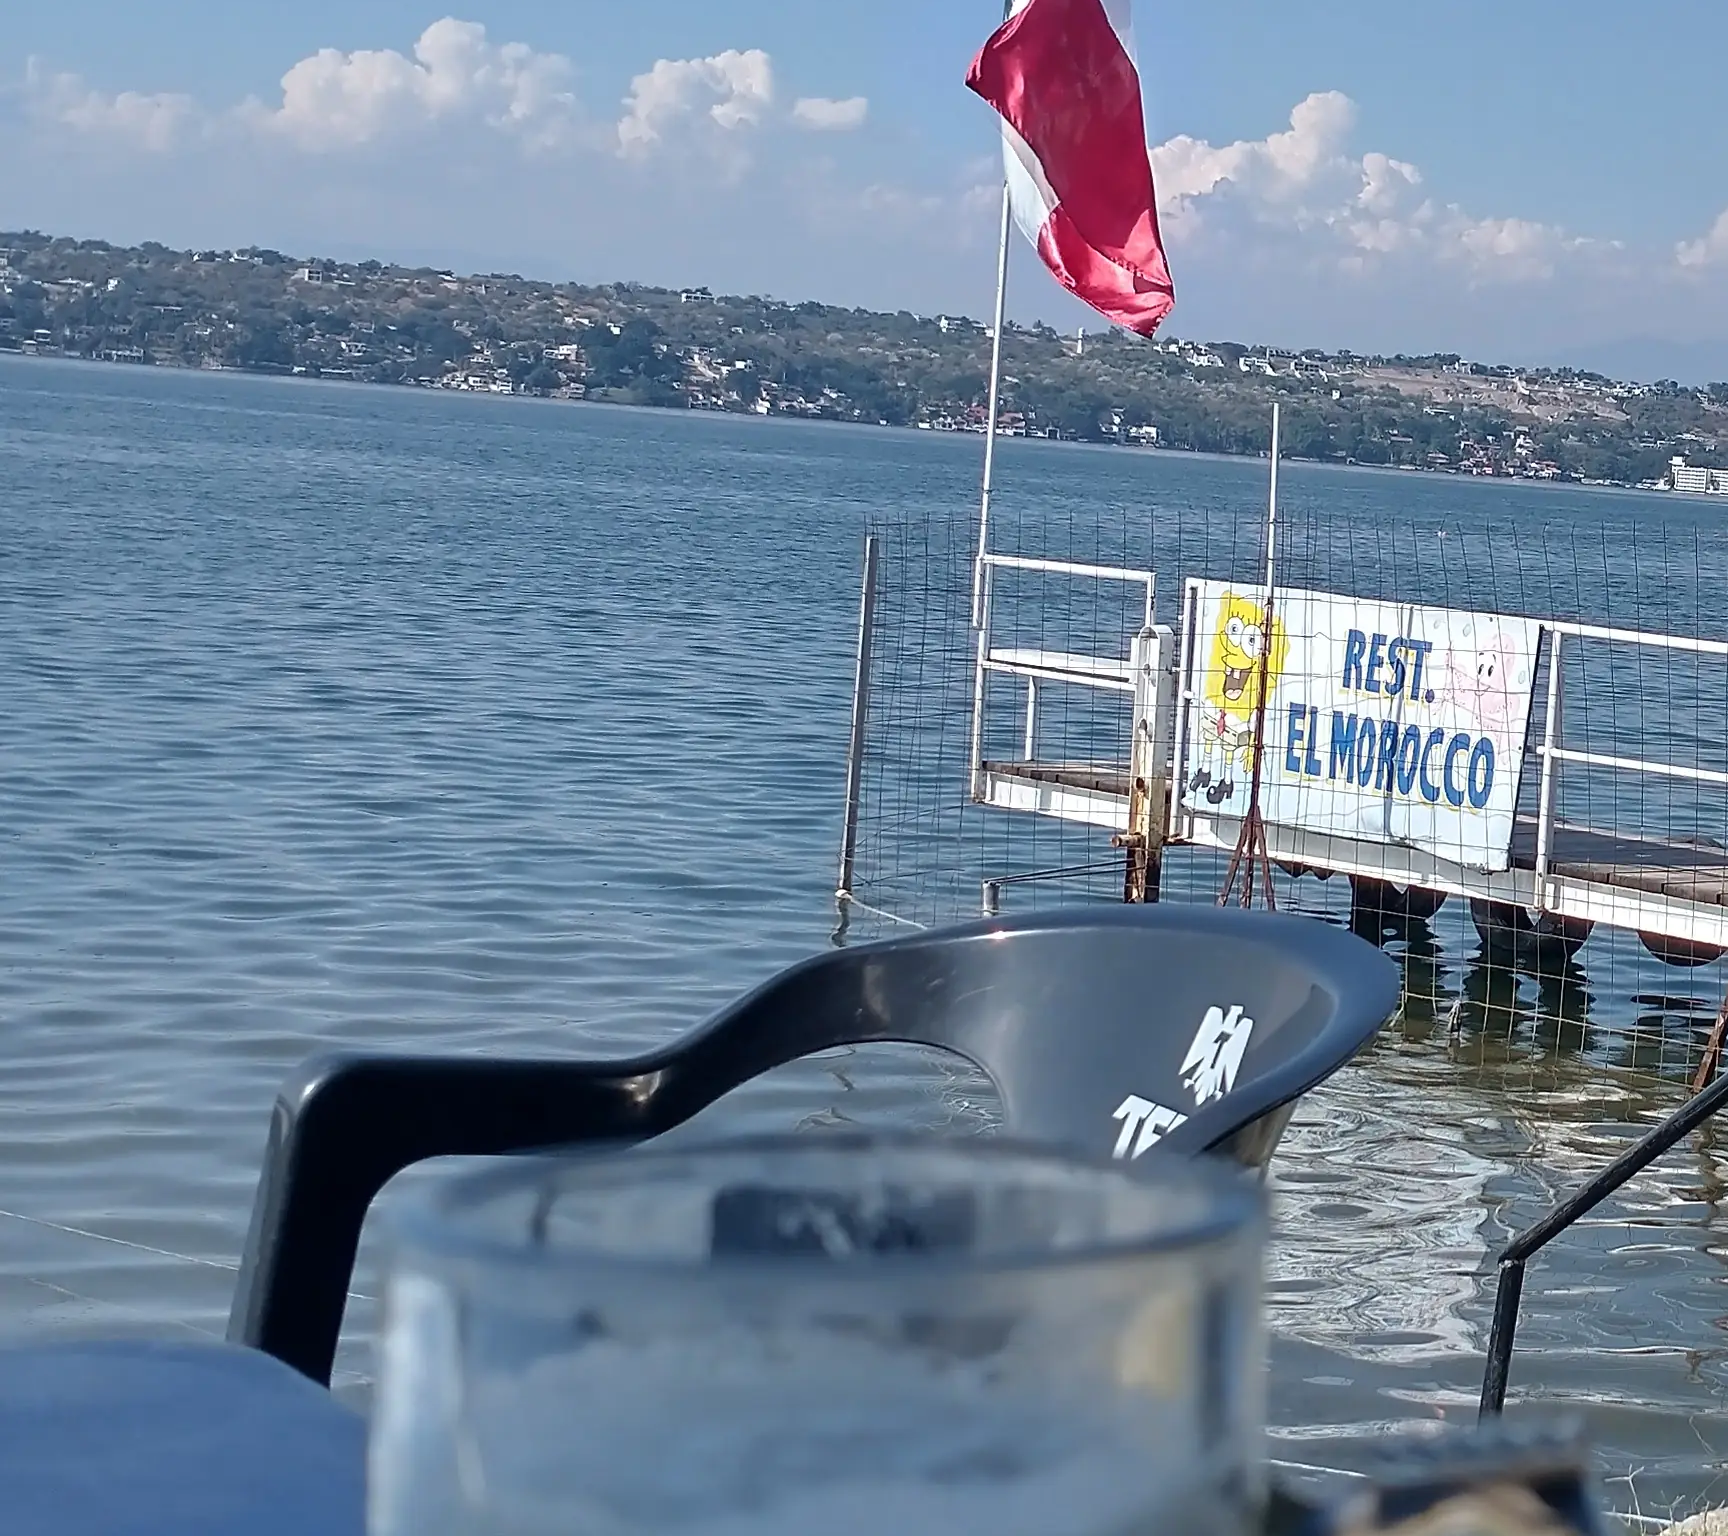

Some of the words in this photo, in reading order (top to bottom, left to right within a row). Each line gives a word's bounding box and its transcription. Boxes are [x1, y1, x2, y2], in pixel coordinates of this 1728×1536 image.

[1341, 628, 1436, 704] REST.
[1284, 701, 1322, 778] EL
[1328, 709, 1495, 809] MOROCCO
